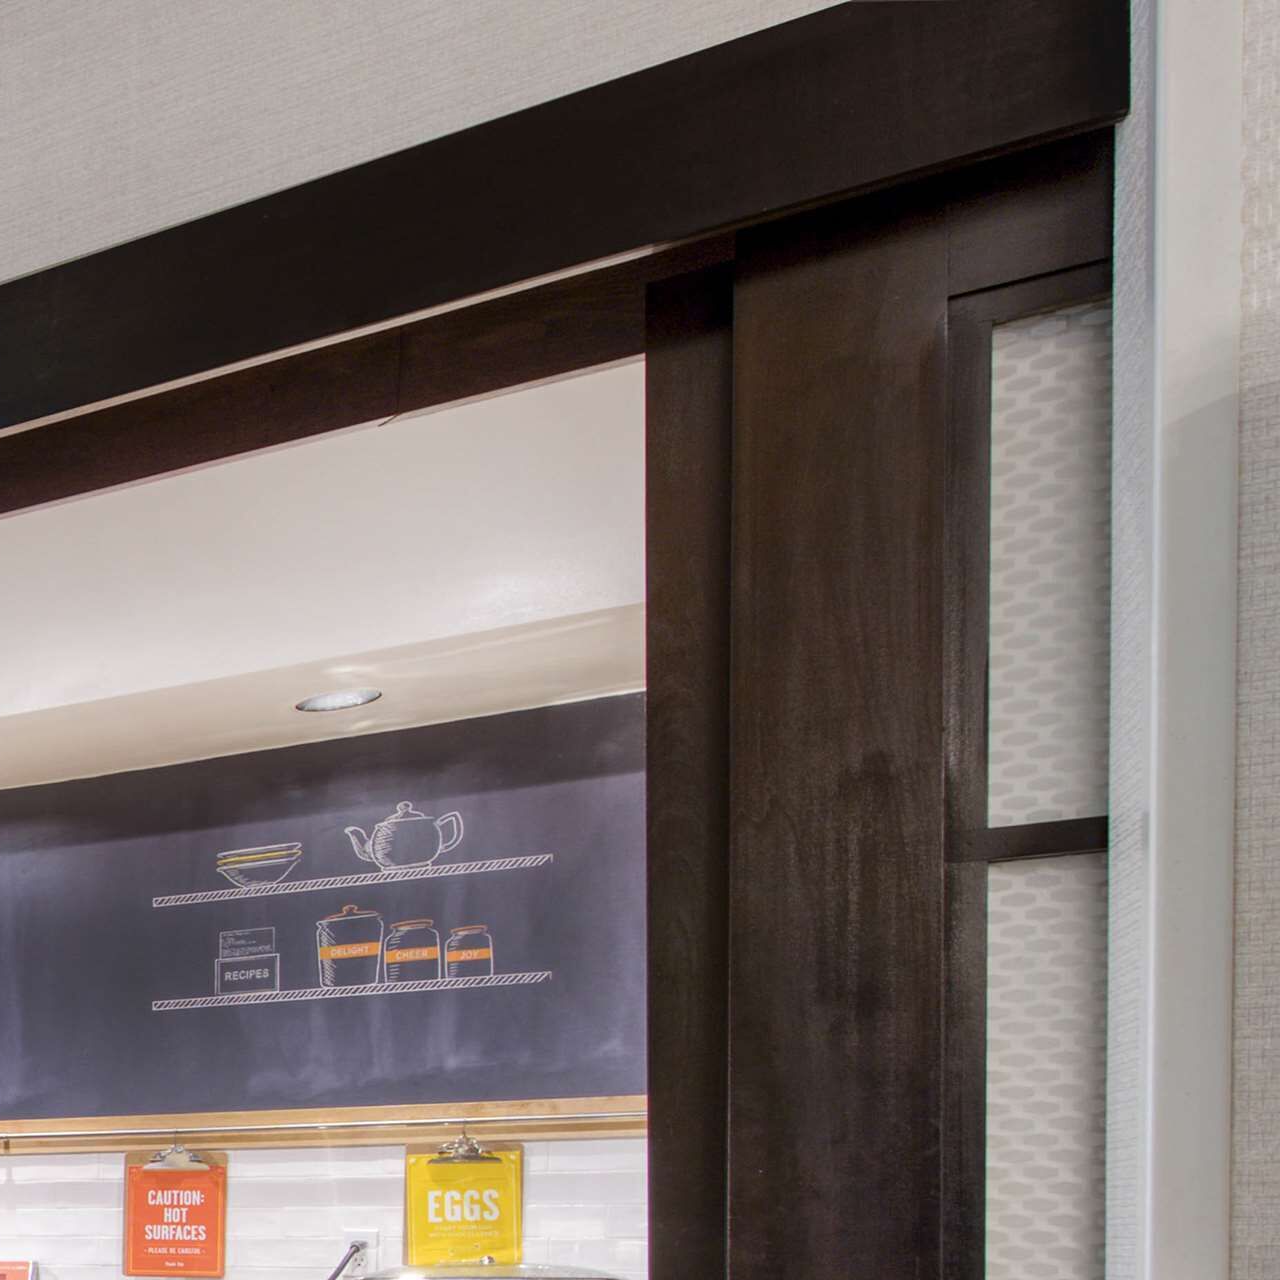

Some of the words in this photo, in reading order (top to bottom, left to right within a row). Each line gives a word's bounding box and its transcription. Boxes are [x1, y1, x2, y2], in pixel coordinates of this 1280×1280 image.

[330, 945, 370, 957] DELIGHT
[395, 949, 428, 960] CHEER
[459, 949, 480, 960] JOY
[224, 968, 270, 981] RECIPES
[147, 1189, 205, 1206] CAUTION:
[427, 1188, 500, 1223] EGGS
[163, 1207, 189, 1223] HOT
[144, 1224, 207, 1241] SURFACES
